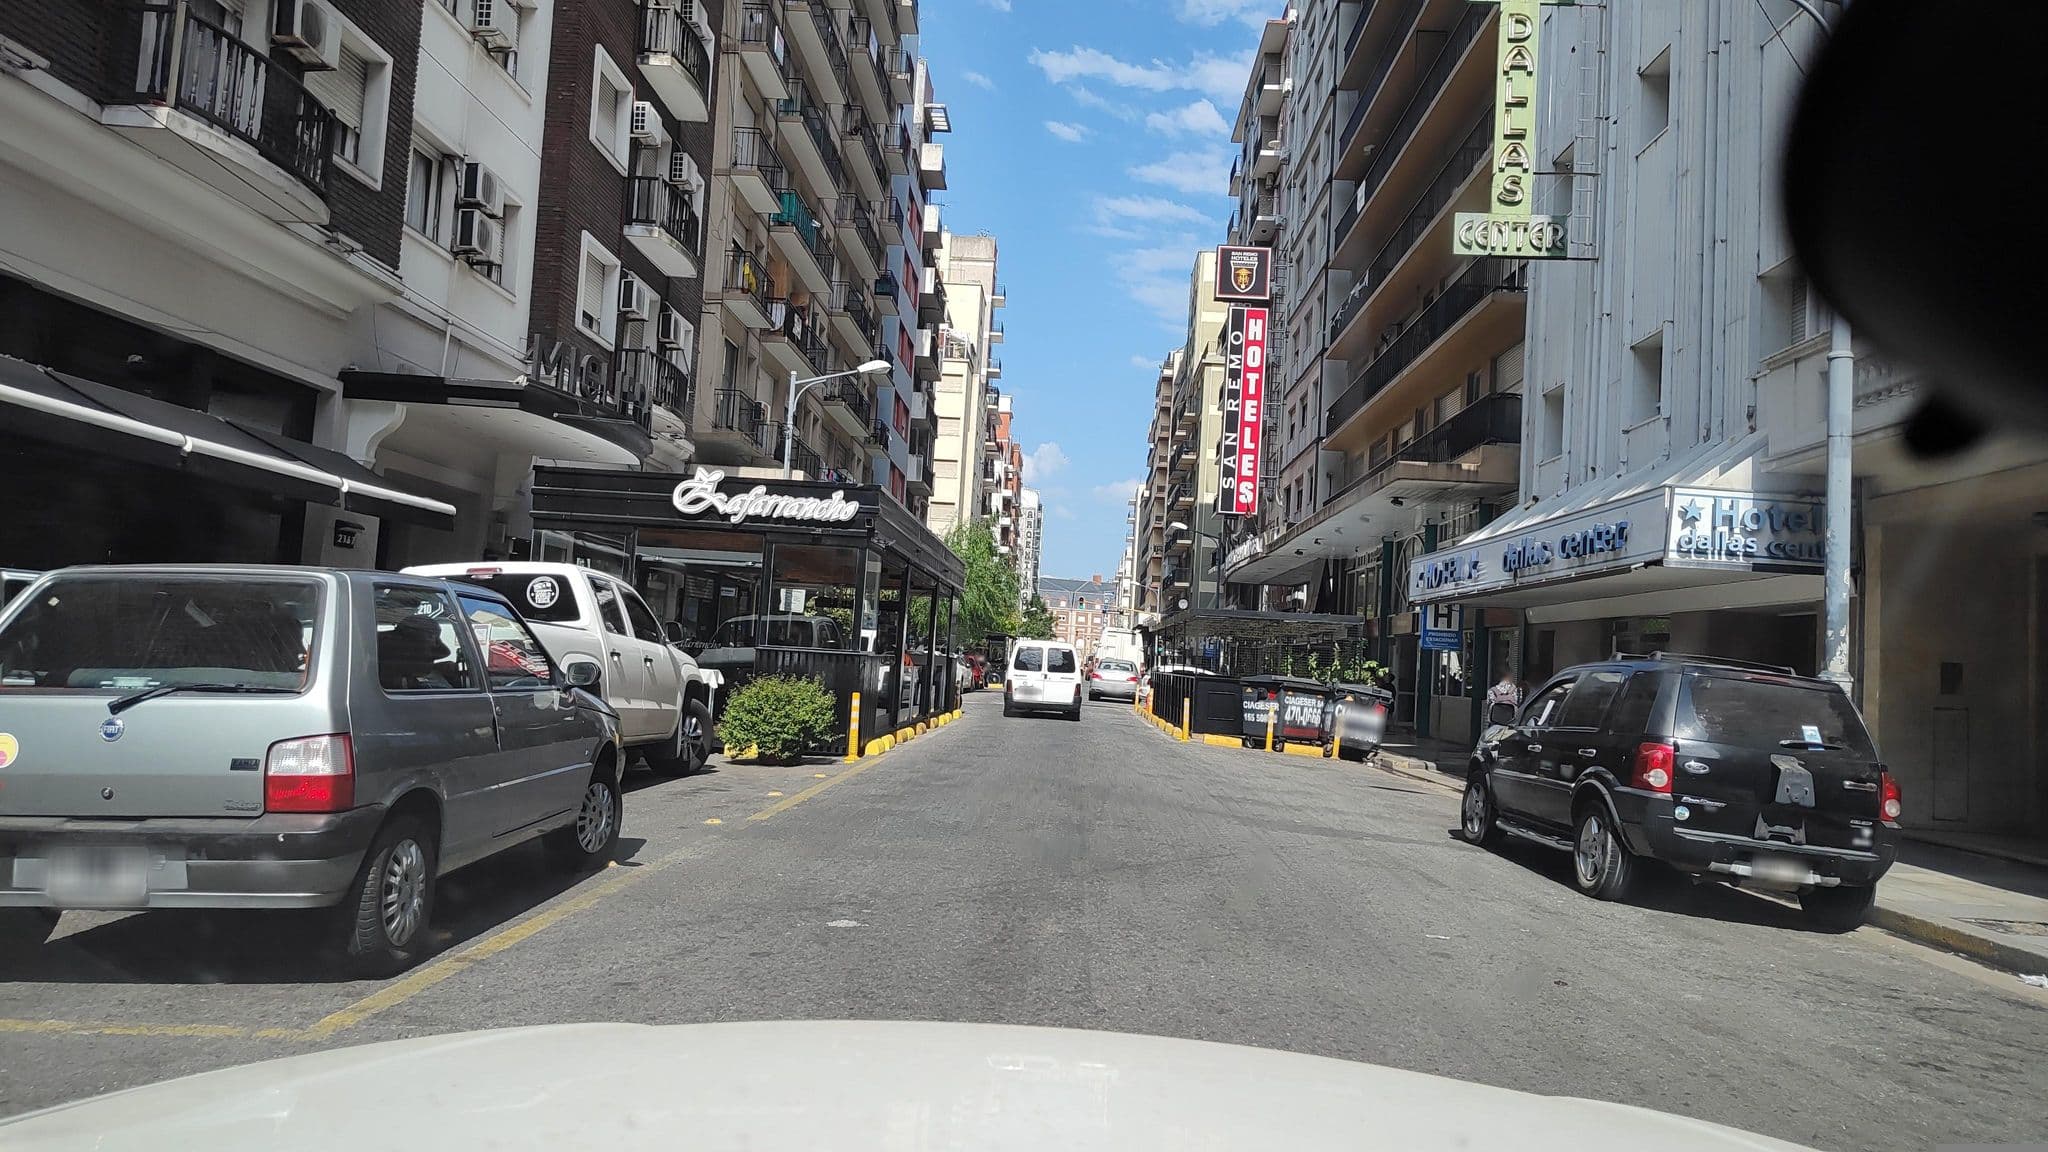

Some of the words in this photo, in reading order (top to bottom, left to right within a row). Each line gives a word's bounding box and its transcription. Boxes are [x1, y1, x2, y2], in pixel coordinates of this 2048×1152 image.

[1498, 13, 1535, 204] DALLAS
[1459, 220, 1565, 251] CENTER
[1227, 331, 1244, 410] REMO
[1239, 319, 1263, 505] HOTELES
[1223, 433, 1238, 489] SAN
[673, 467, 859, 524] Zafarrancho
[1714, 497, 1824, 533] Hotel
[1558, 520, 1629, 560] center
[1680, 526, 1757, 552] dallas
[103, 725, 119, 734] FIAT
